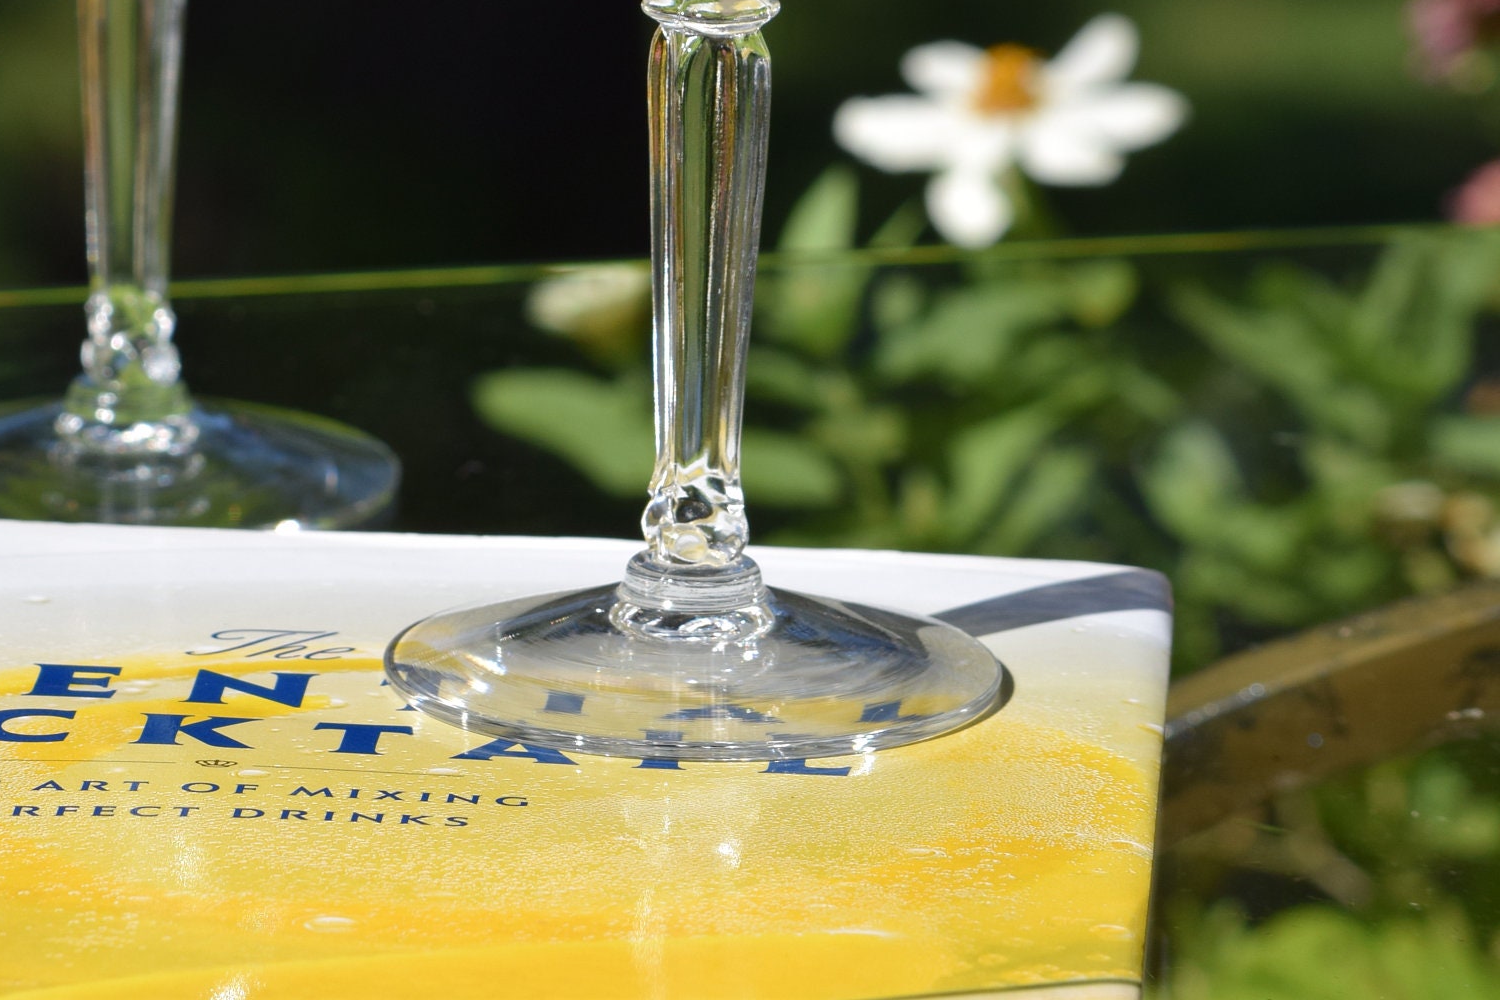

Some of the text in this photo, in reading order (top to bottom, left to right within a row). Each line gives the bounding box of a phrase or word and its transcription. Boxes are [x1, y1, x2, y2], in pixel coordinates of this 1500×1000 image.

[184, 628, 357, 661] The
[31, 779, 150, 792] ART
[181, 781, 260, 795] OF
[289, 785, 529, 807] MIXING
[231, 807, 469, 827] DRINKS
